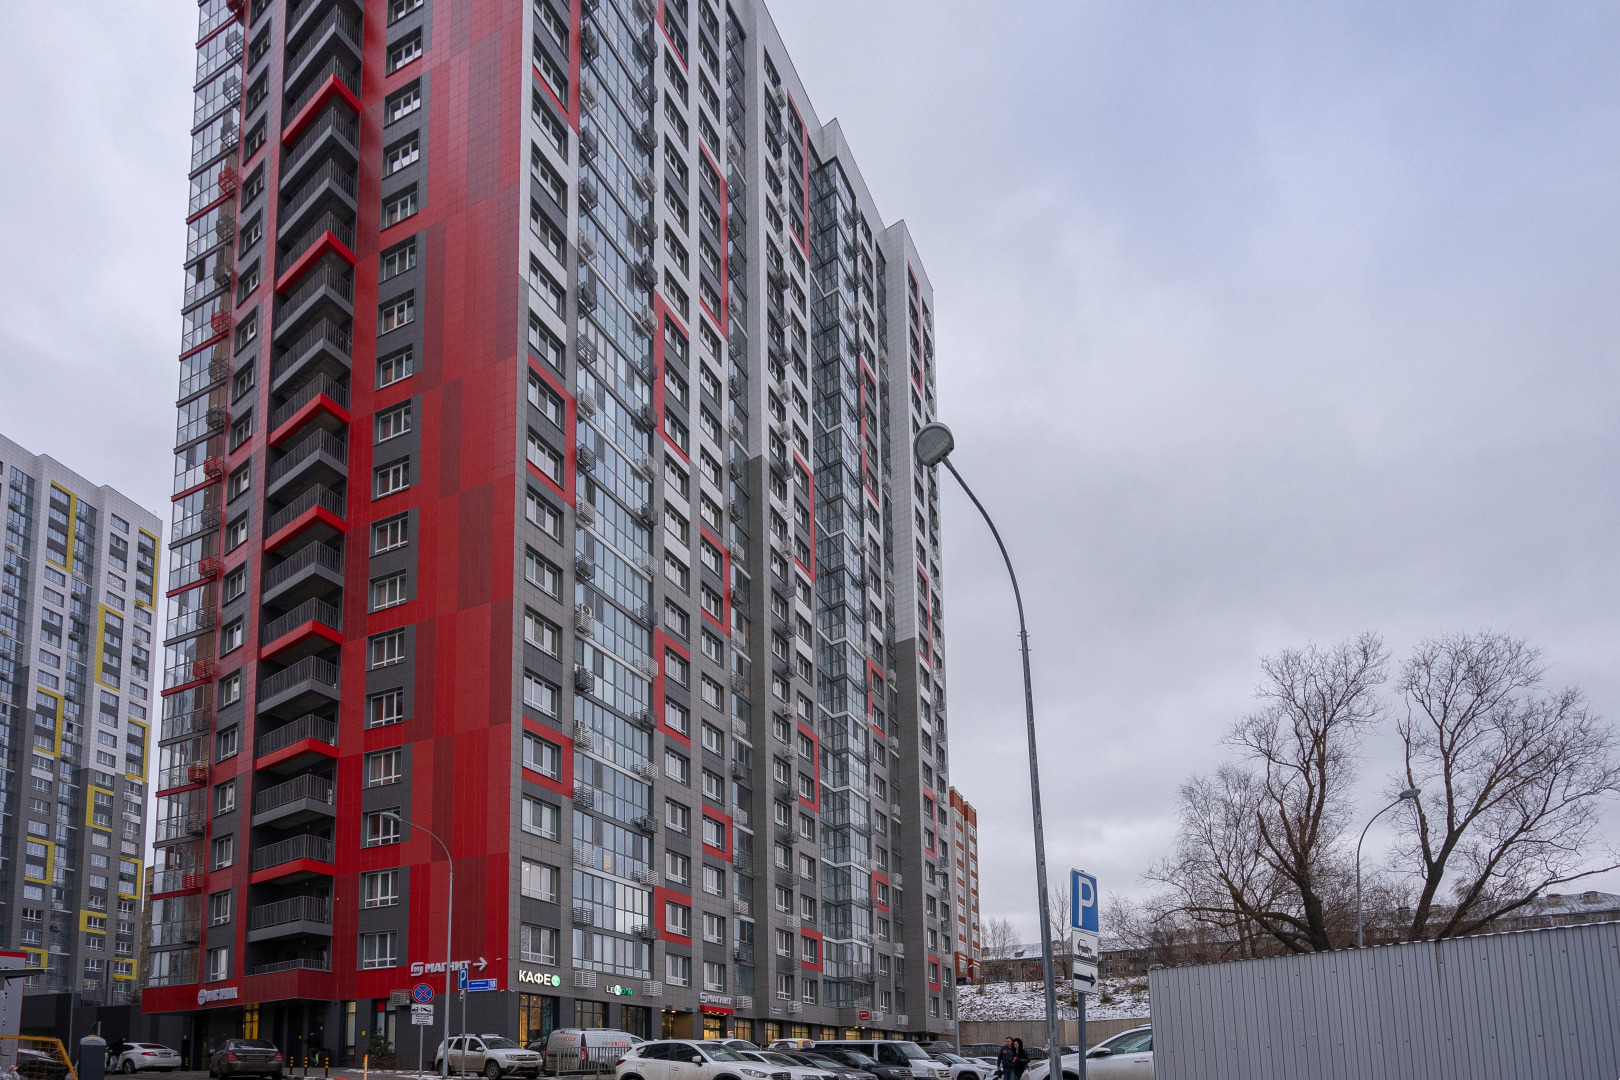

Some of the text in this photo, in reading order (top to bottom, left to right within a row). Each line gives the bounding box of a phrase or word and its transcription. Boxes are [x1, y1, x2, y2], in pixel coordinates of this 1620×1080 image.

[1078, 875, 1095, 927] P
[519, 969, 552, 986] КАФЕ
[707, 995, 732, 1005] МАГНИТ
